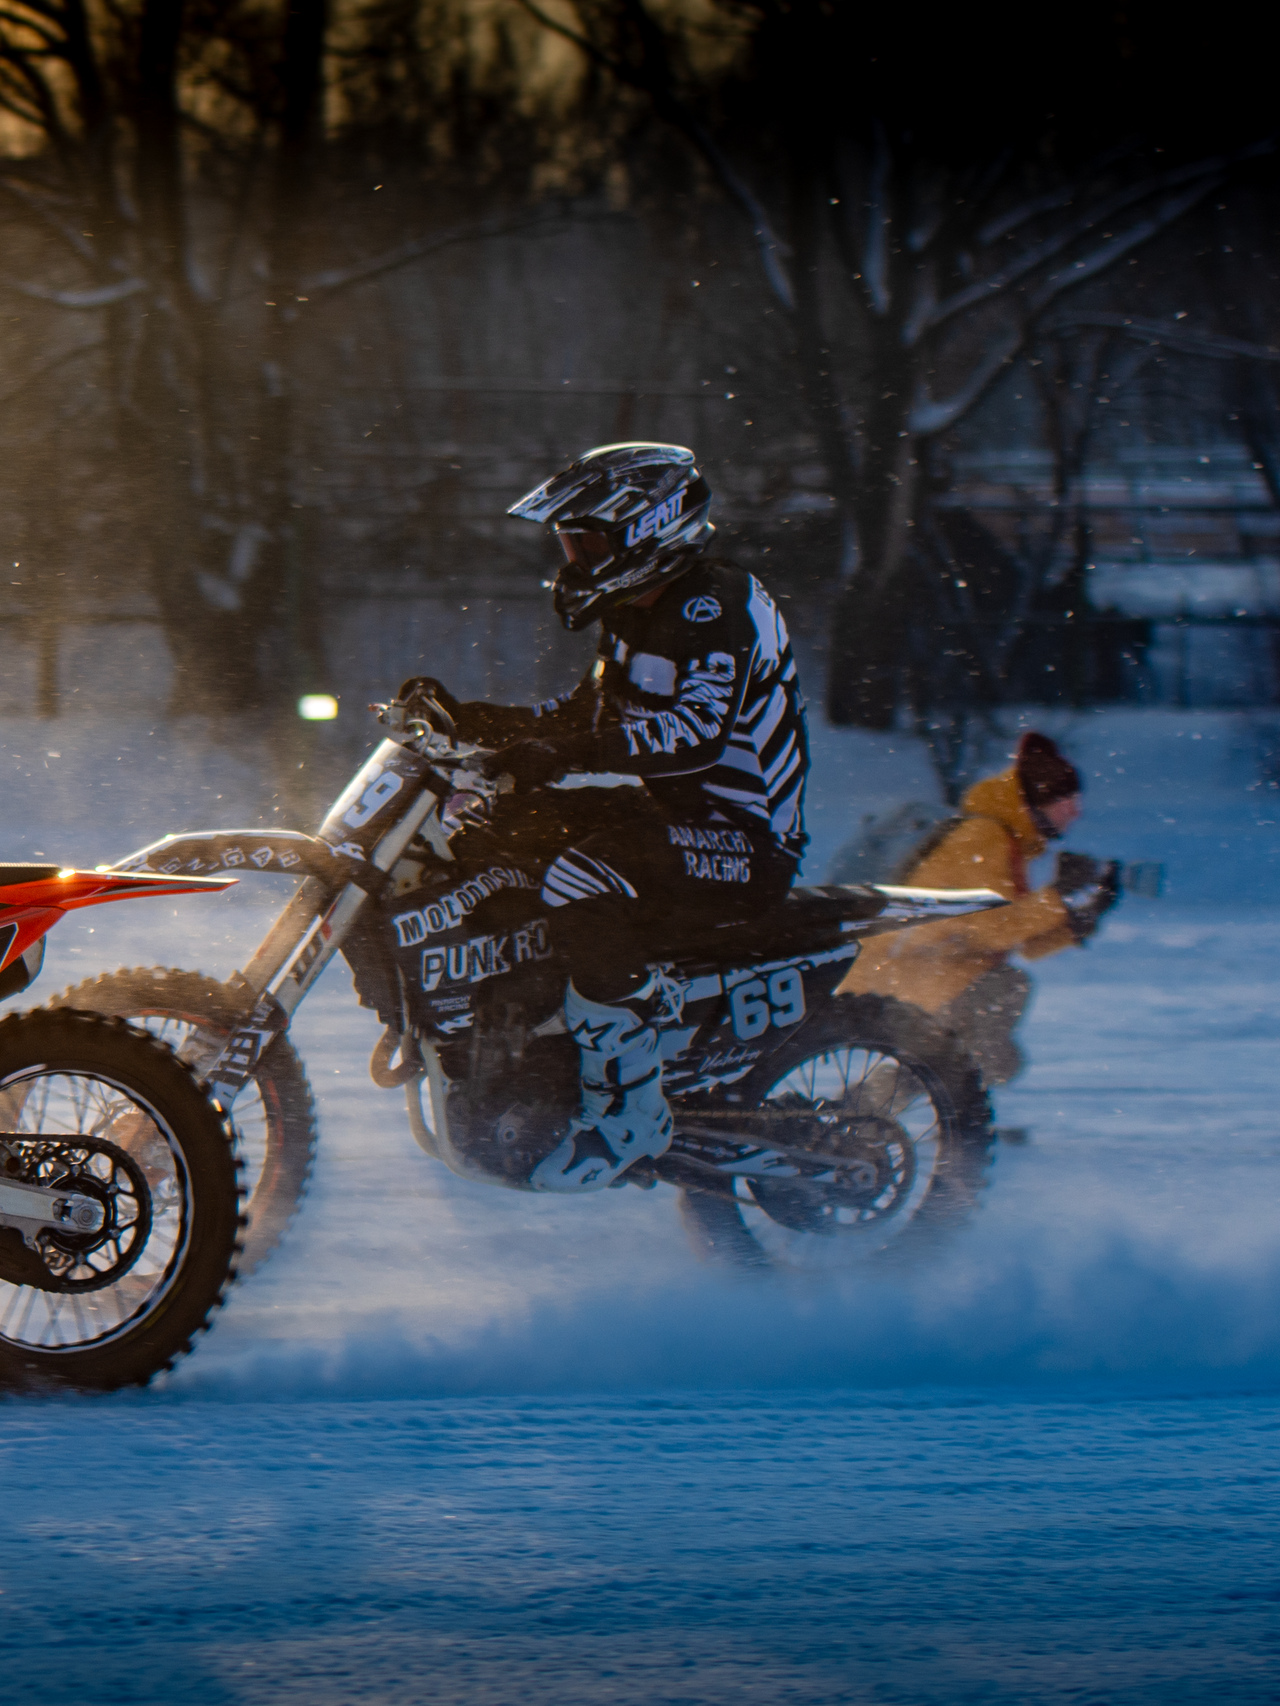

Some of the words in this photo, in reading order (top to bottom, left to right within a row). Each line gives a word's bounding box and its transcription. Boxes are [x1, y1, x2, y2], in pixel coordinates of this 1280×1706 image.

[625, 488, 688, 548] LEATT
[682, 850, 752, 883] RACING
[421, 934, 512, 992] PUNK
[729, 966, 806, 1041] 69
